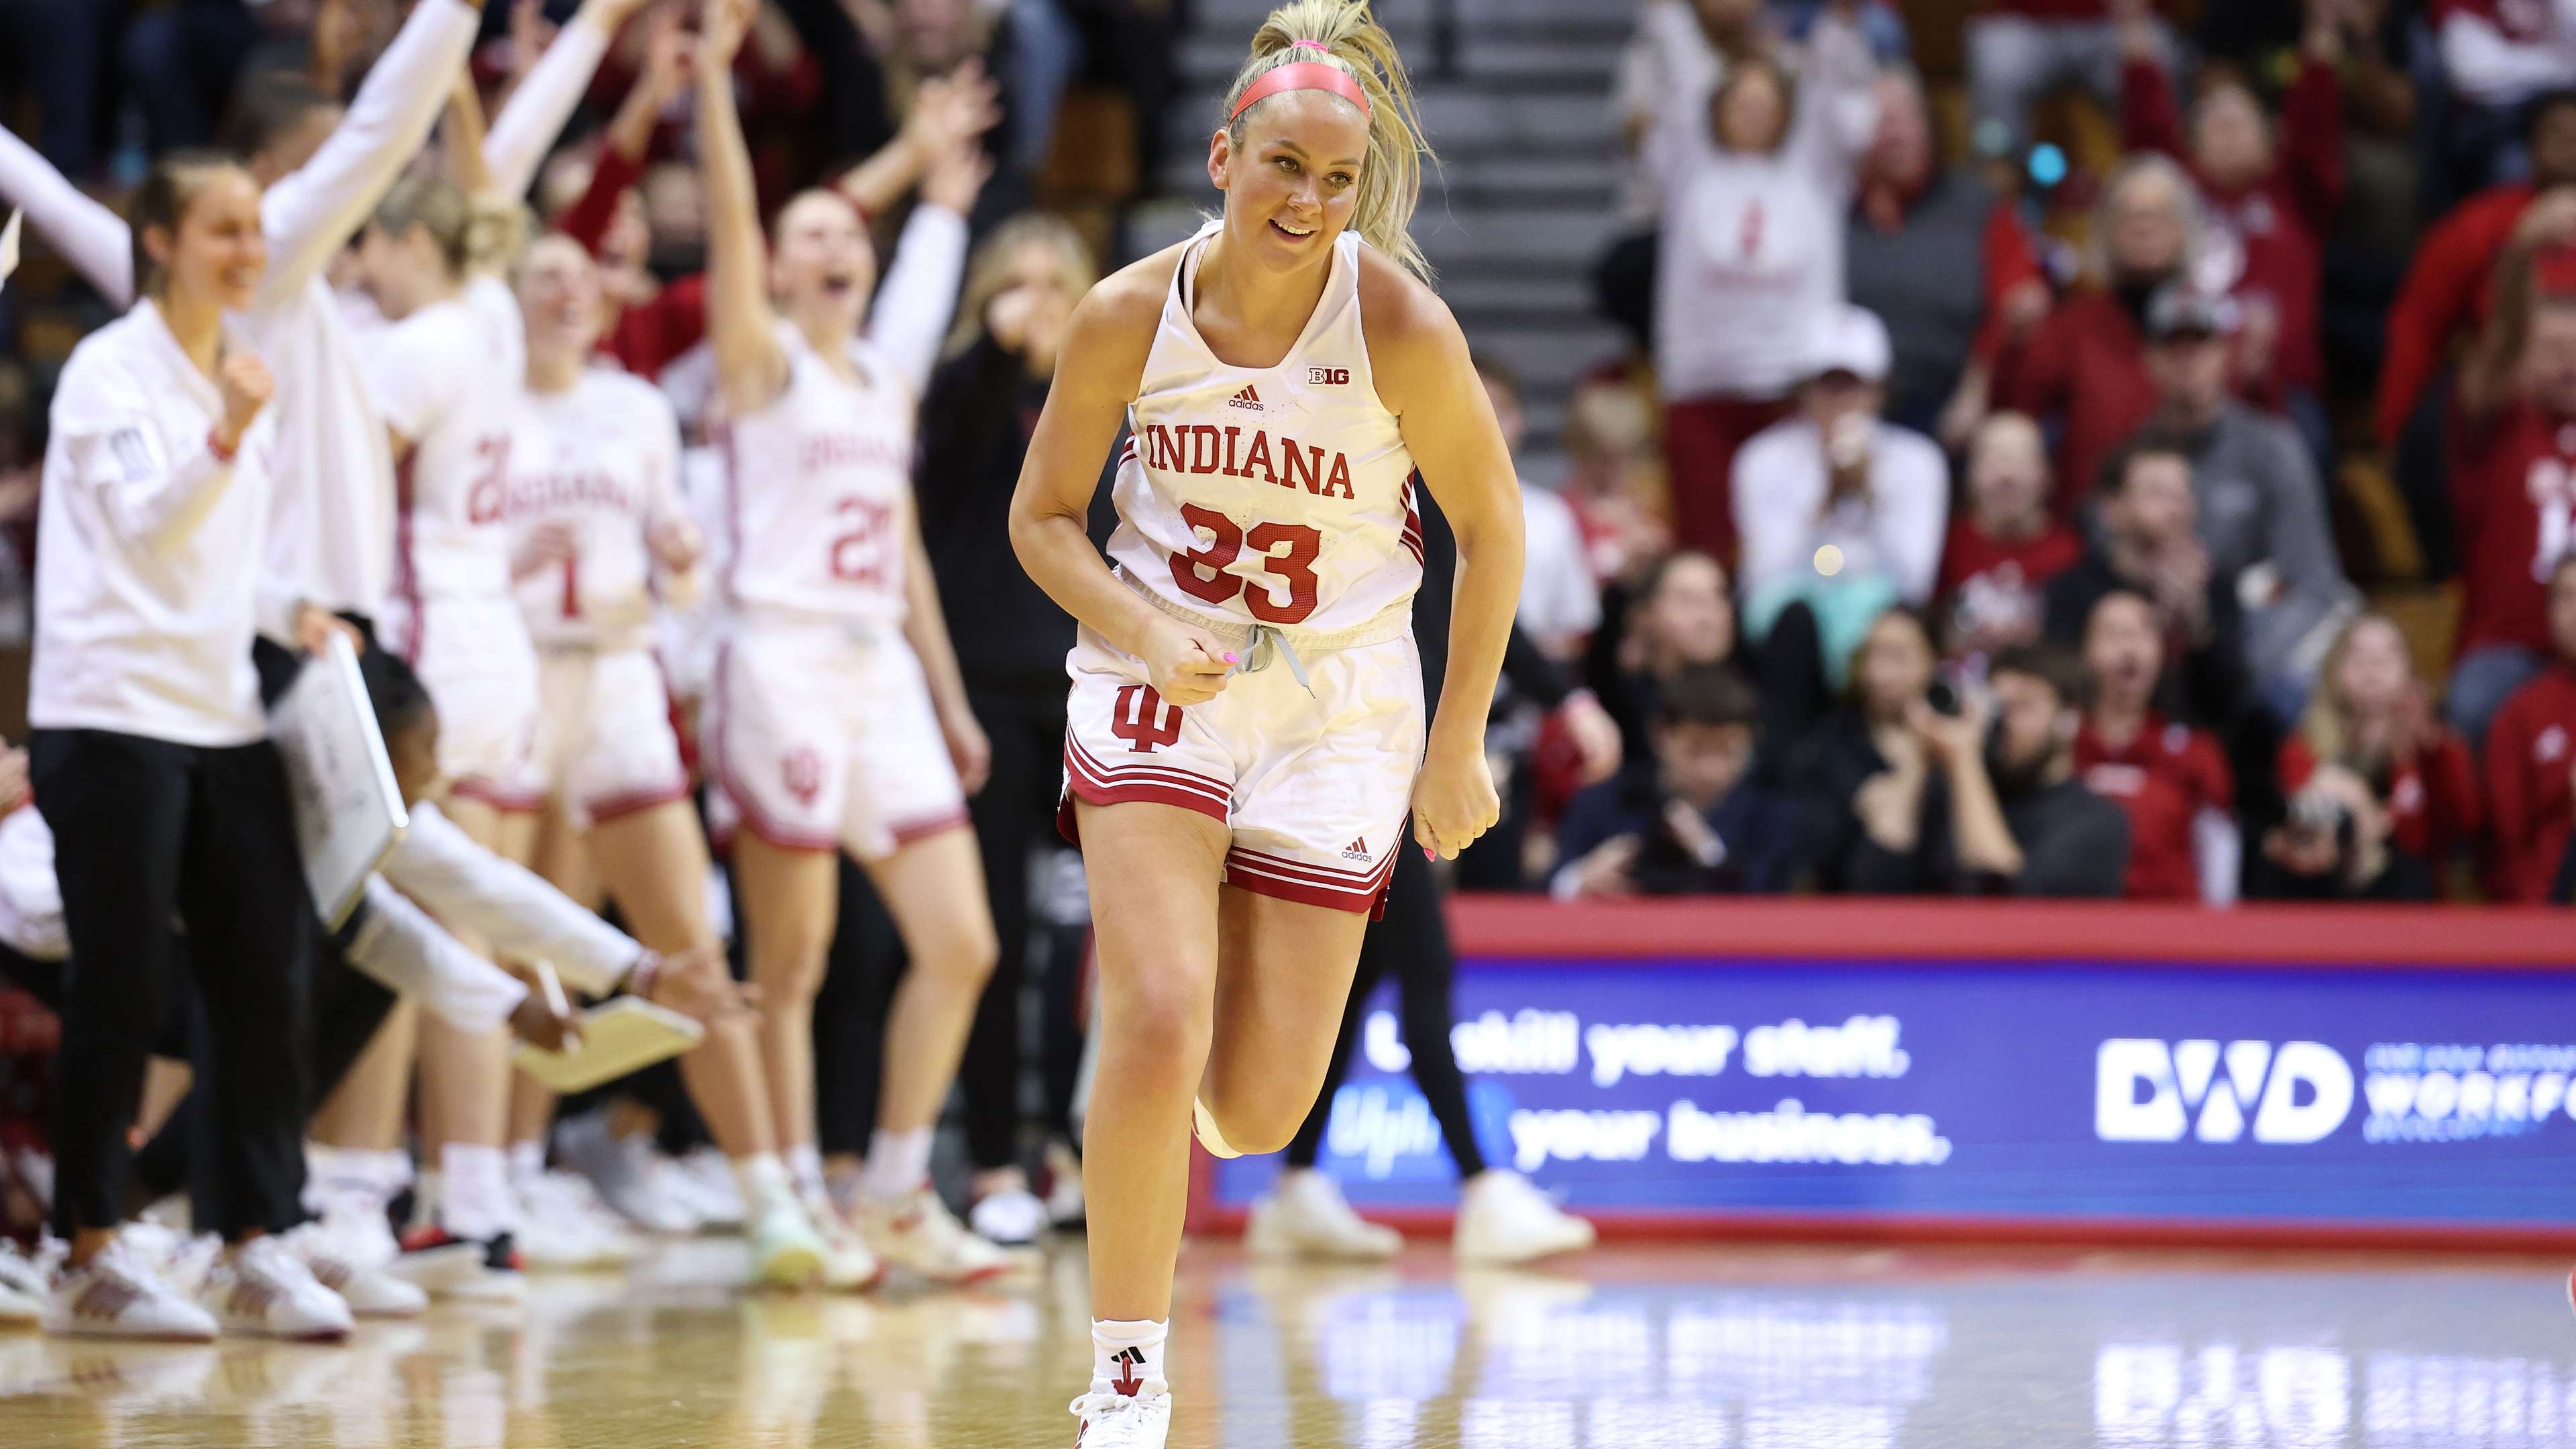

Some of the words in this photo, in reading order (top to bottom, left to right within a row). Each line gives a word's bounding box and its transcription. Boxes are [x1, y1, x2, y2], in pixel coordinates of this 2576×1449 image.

[1228, 398, 1264, 411] adidas
[1146, 425, 1354, 500] INDIANA
[1169, 502, 1322, 624] 33
[1342, 850, 1373, 863] adidas
[1585, 1024, 1737, 1087] your
[2095, 1038, 2354, 1143] DWD
[1509, 1110, 1660, 1172] your
[1668, 1099, 1951, 1164] business.
